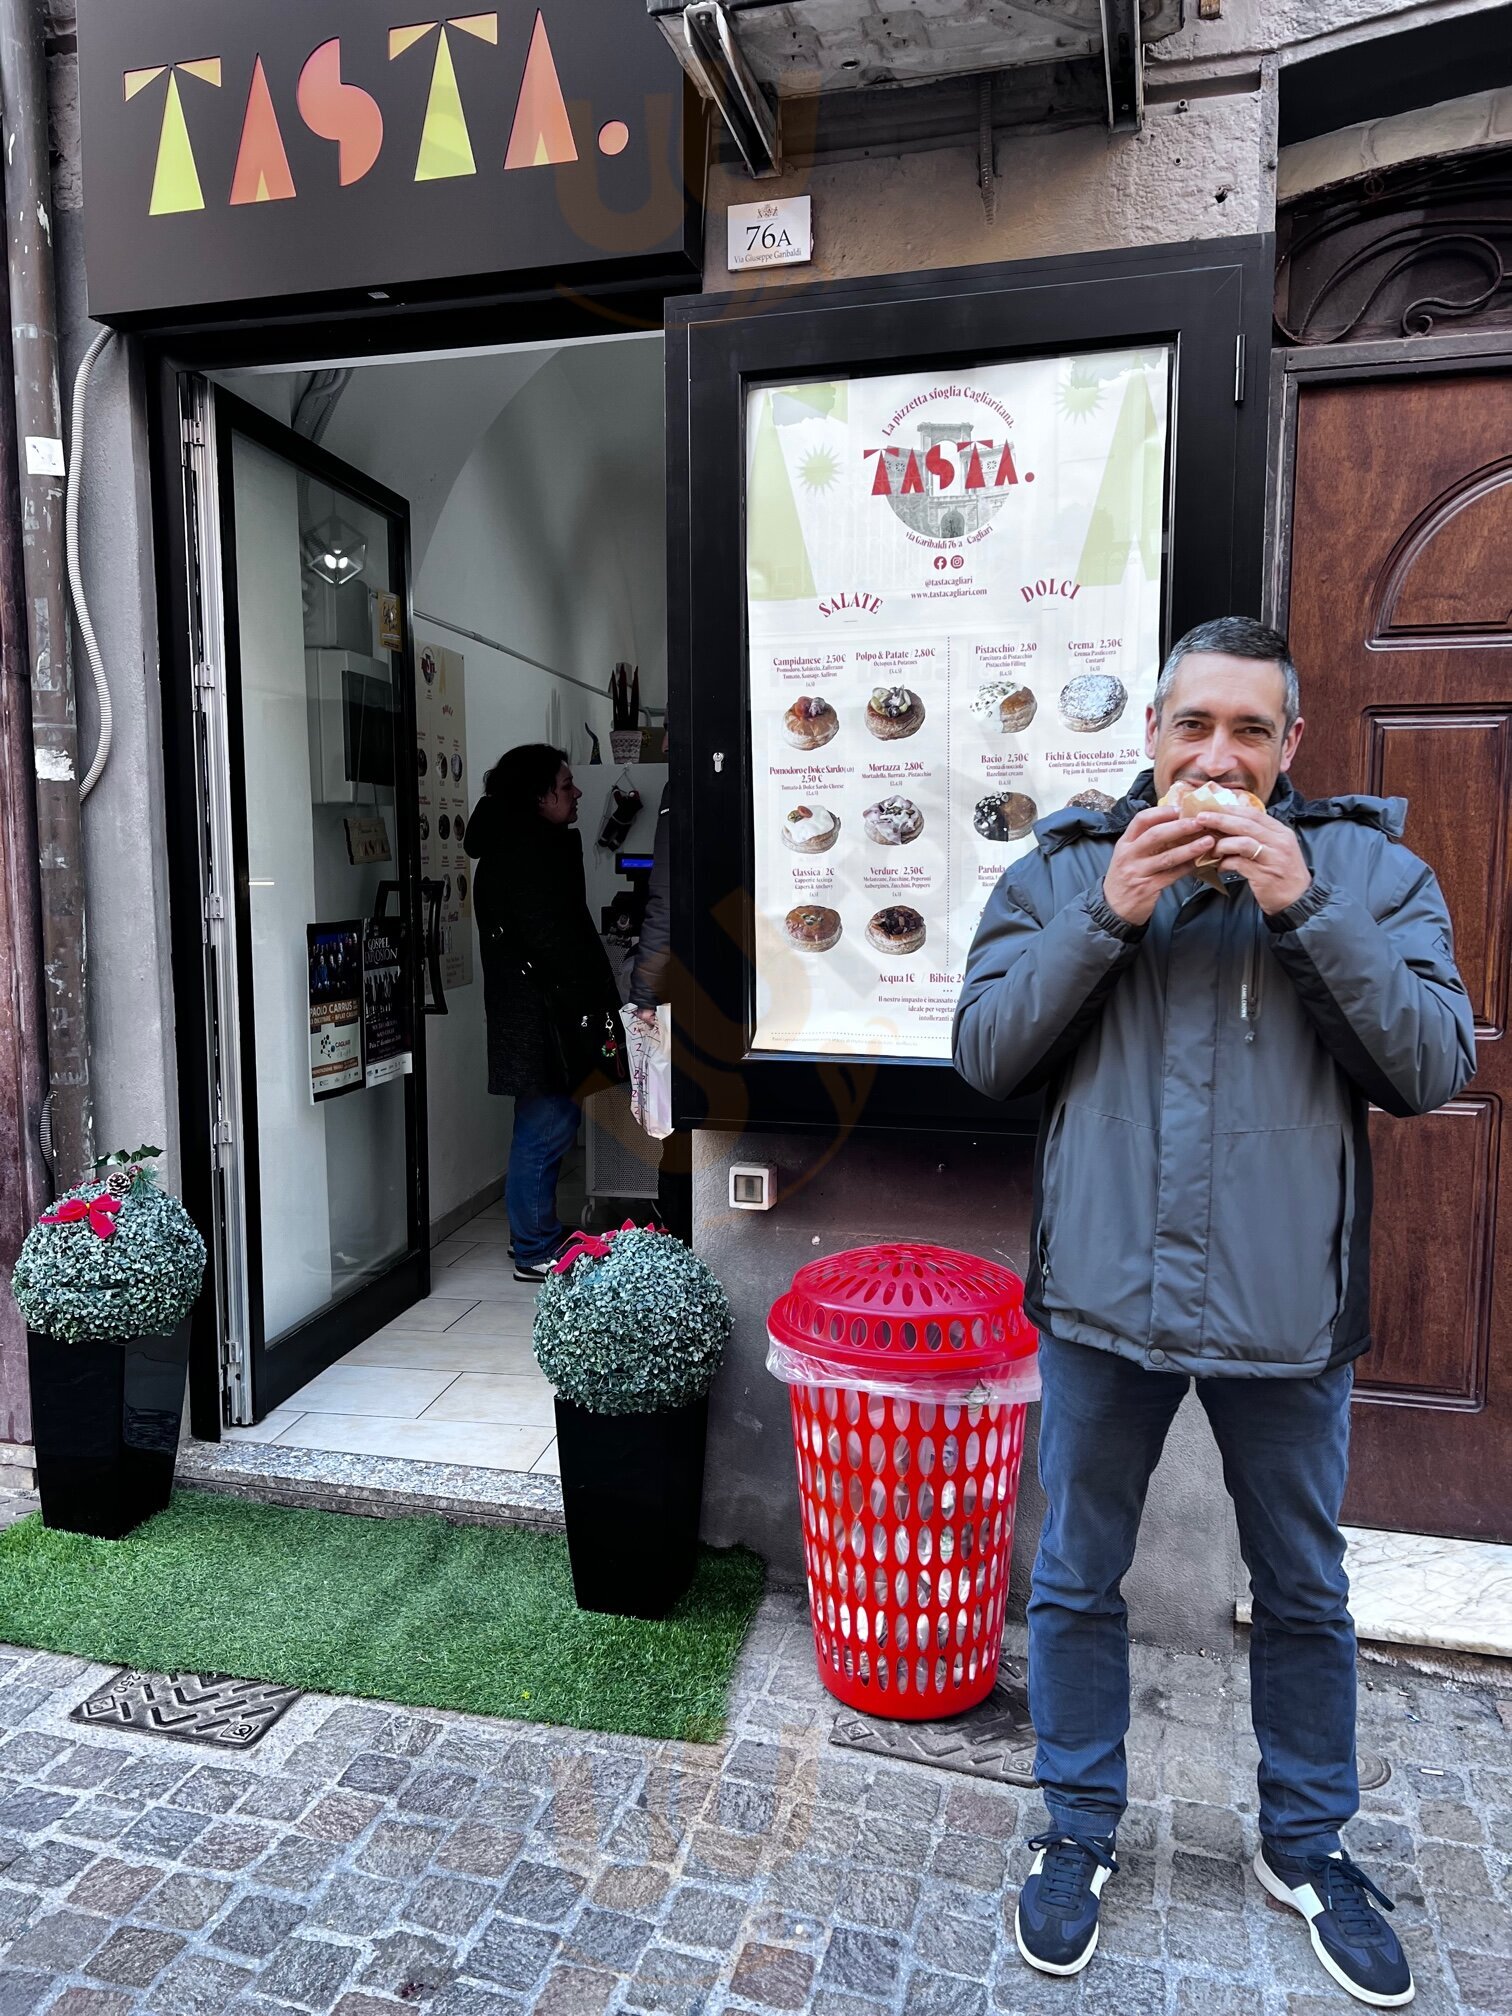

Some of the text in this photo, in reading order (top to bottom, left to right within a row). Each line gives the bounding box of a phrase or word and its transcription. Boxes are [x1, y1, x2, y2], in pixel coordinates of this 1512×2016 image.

[123, 7, 629, 216] TASTA.
[746, 223, 792, 251] 76A
[734, 248, 802, 263] Via Giuseppe Garibaldi
[881, 385, 1015, 437] La pizzetta sfoglia Cagliaritana.
[863, 438, 1036, 496] TASTA.
[905, 531, 915, 541] via
[915, 534, 947, 550] Garibaldi
[947, 539, 957, 549] 76
[966, 524, 994, 545] Cagliari
[924, 576, 973, 588] @tastacagliari
[910, 587, 987, 600] www.tastacagliari.com
[1019, 578, 1081, 604] DOLCI
[818, 592, 884, 618] SALATE
[975, 644, 1015, 654] Pistacchio
[1068, 641, 1094, 650] Crema
[855, 651, 877, 662] Polpo
[878, 651, 885, 660] &
[885, 650, 909, 660] Patate
[773, 656, 821, 669] Campidanese
[981, 755, 1002, 764] Bacio
[1045, 752, 1066, 761] Fichi
[1066, 752, 1072, 761] &
[1073, 751, 1115, 761] Cioccolato
[769, 766, 803, 775] Pomodoro
[807, 766, 825, 774] Dolce
[825, 765, 844, 774] Sardo
[868, 763, 900, 773] Mortazza
[792, 867, 835, 877] Classica 2€
[870, 867, 899, 876] Verdure
[879, 973, 904, 985] Acqua
[905, 973, 915, 983] 1€
[929, 973, 955, 983] Bibite
[310, 1005, 327, 1017] PAOLO
[329, 1001, 353, 1014] CARRUS
